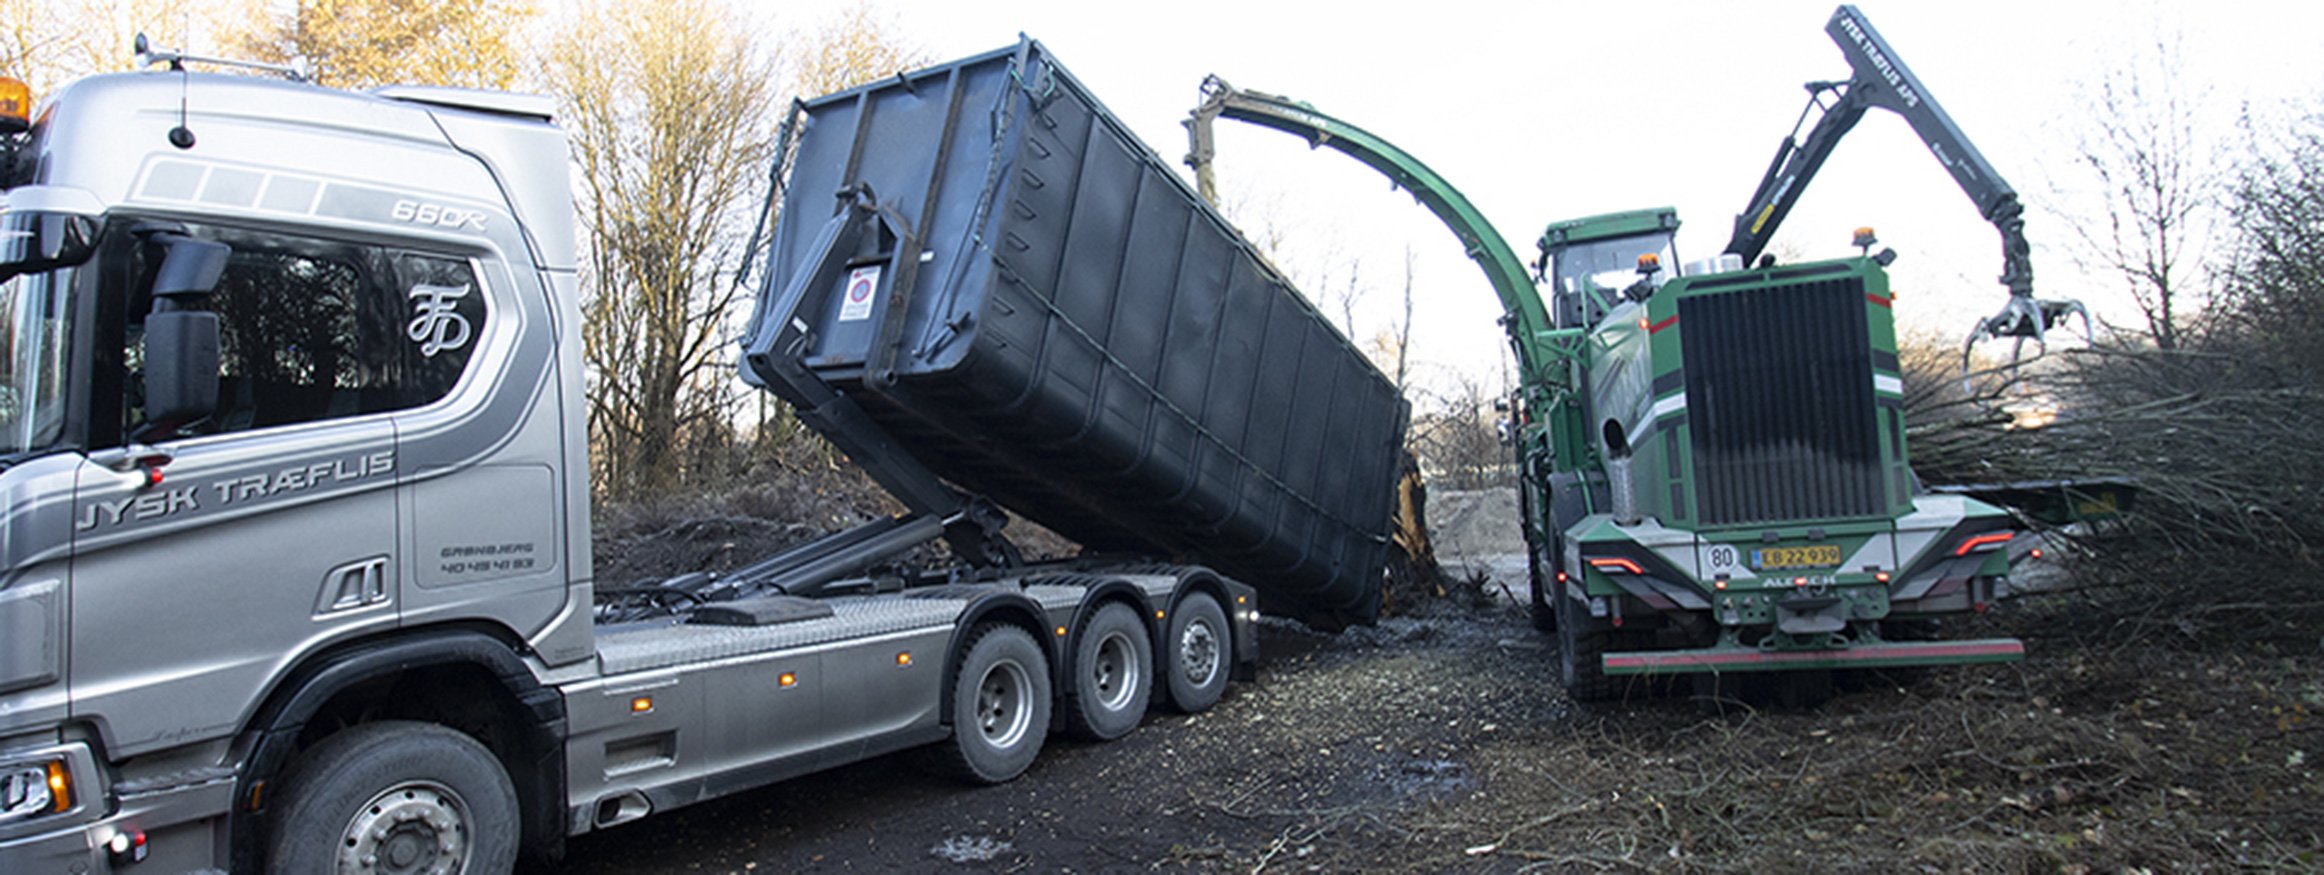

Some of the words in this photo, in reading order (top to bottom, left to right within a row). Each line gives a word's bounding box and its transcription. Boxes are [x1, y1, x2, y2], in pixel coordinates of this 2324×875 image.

[76, 485, 200, 531] JYSK
[213, 451, 397, 504] TRÆFLIS
[1711, 547, 1733, 568] 80
[1762, 550, 1783, 565] EB
[1786, 549, 1805, 564] 22
[1808, 547, 1837, 562] 939
[441, 562, 465, 574] 40
